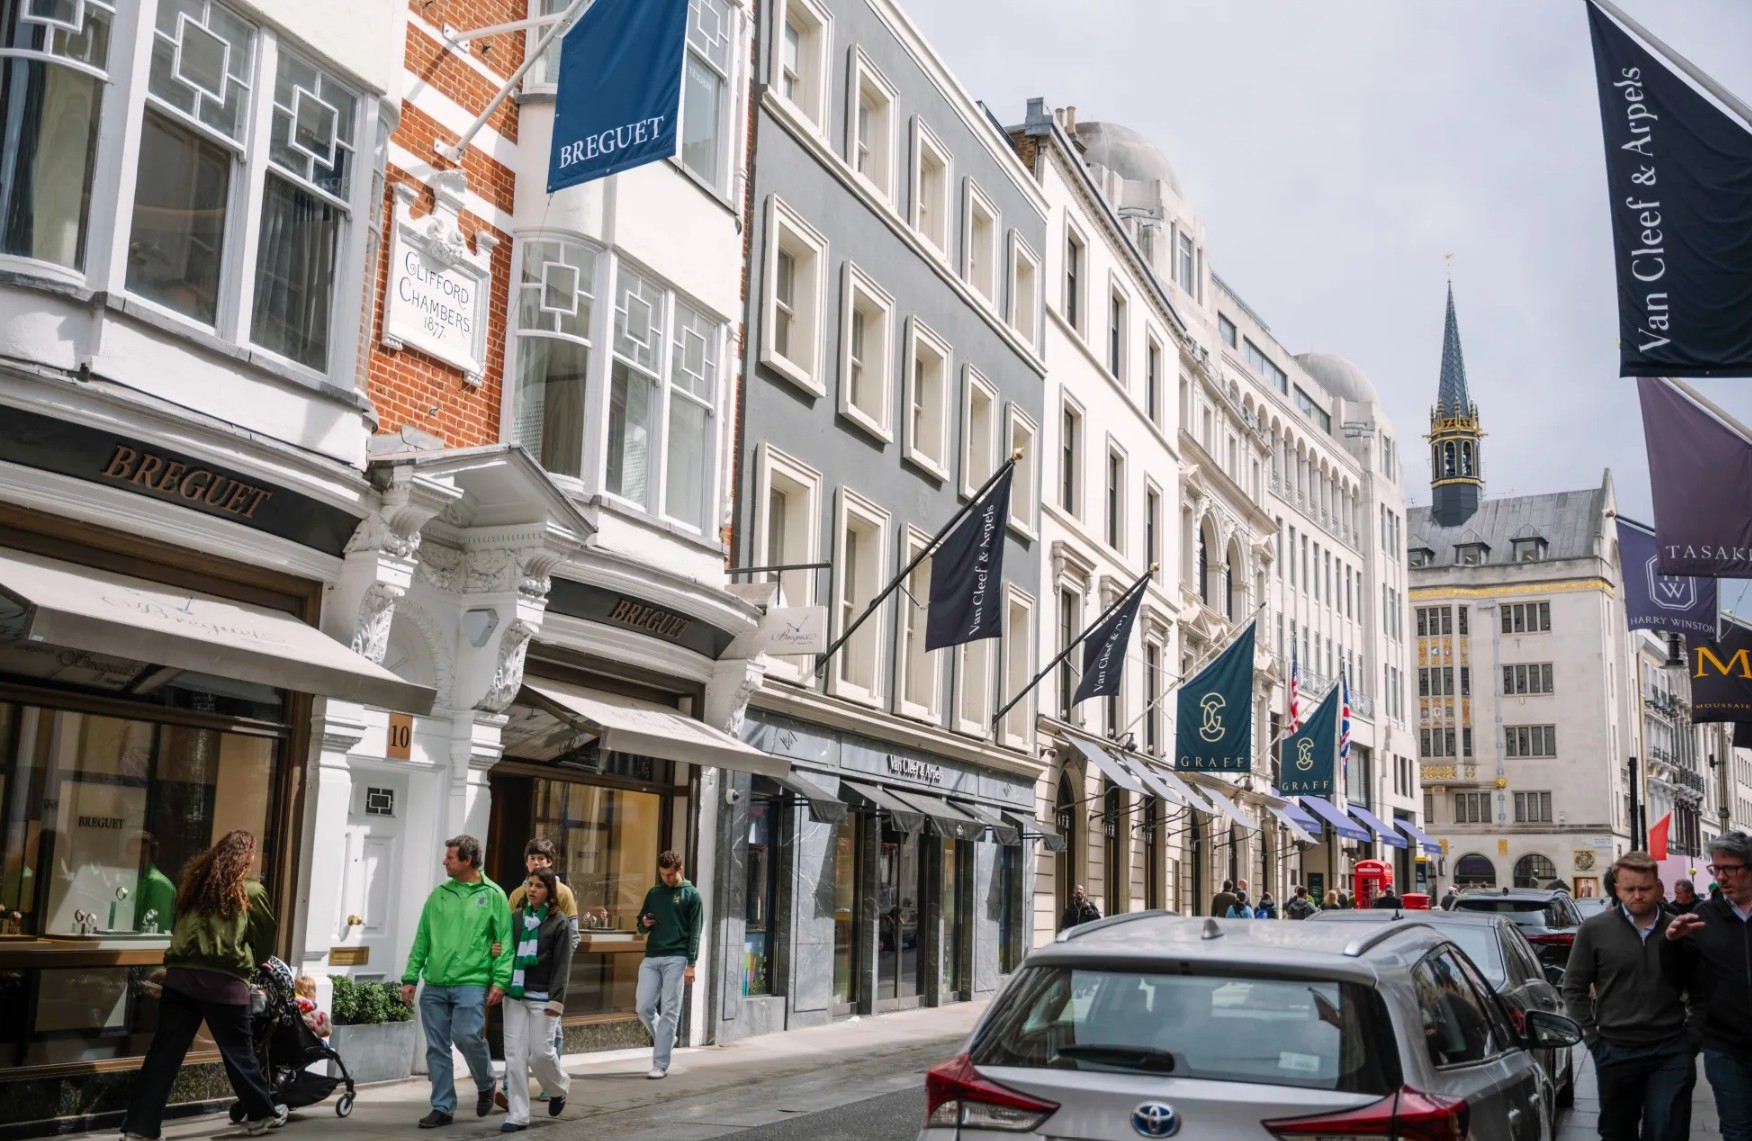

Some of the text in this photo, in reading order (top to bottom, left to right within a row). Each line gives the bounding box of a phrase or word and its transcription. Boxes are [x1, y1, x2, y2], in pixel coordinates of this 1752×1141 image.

[558, 115, 665, 169] BREGUET
[1613, 66, 1671, 353] Van Cleef & Arpels
[405, 251, 469, 309] CLIFFORD
[100, 444, 273, 519] BREGUET
[978, 552, 989, 563] &
[972, 565, 989, 606] Cleef
[608, 600, 693, 639] BREGUET
[968, 607, 983, 636] Van
[1630, 616, 1716, 634] HARRY WINSTON
[1093, 670, 1106, 693] Van
[390, 725, 410, 749] 10
[1180, 755, 1245, 768] GRAFF
[1281, 780, 1329, 791] GRAFF
[78, 815, 125, 829] BREGUET
